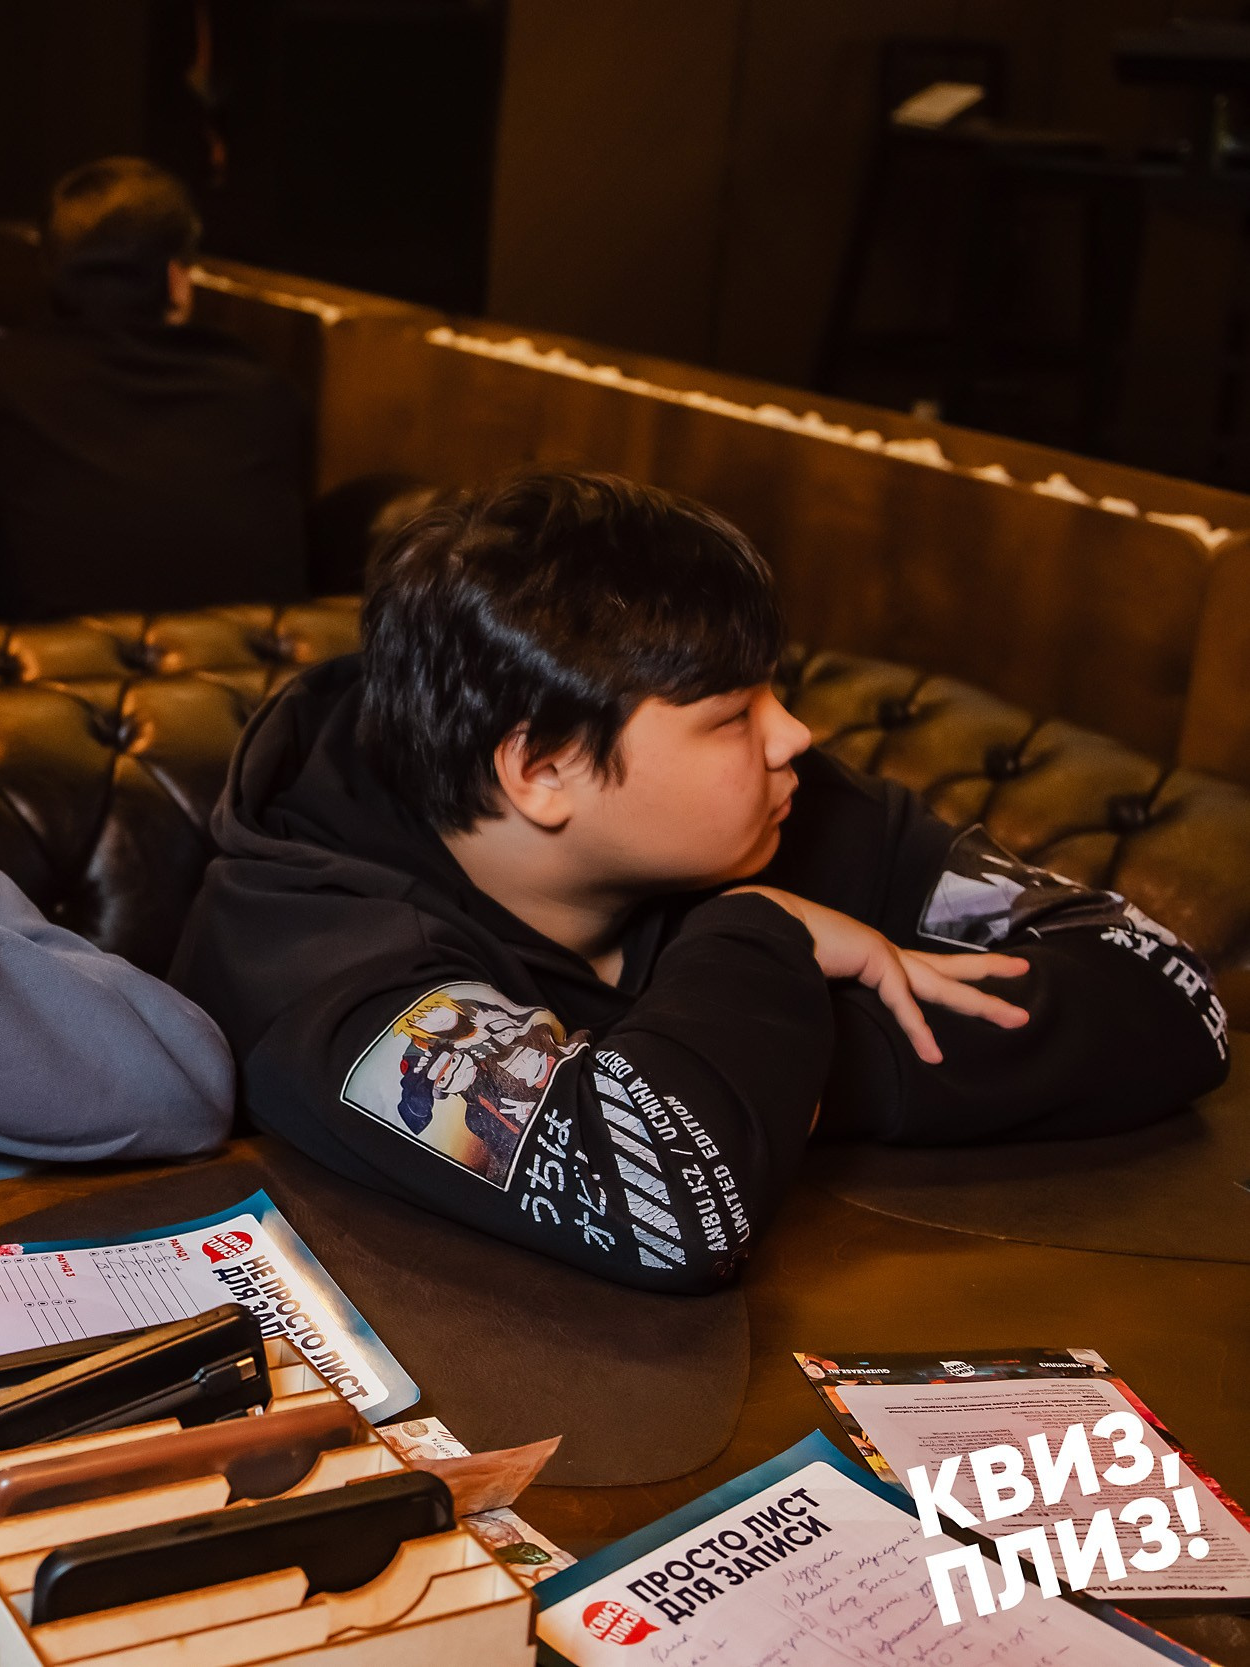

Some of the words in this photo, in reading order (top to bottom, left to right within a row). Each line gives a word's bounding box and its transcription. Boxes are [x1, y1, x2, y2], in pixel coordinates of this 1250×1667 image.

[627, 1076, 678, 1142] UCHIHA
[663, 1095, 720, 1160] EDITION
[520, 1109, 572, 1225] うちは
[682, 1164, 728, 1252] ANBU.KZ
[55, 1254, 71, 1273] РАУНД
[170, 1239, 188, 1259] РАУНД
[212, 1266, 261, 1302] ДЛЯ
[242, 1254, 271, 1280] НЕ
[258, 1276, 328, 1350] ПРОСТО
[311, 1349, 370, 1400] ЛИСТ
[626, 1530, 748, 1603] ПРОСТО
[741, 1488, 820, 1540] ЛИСТ
[654, 1577, 725, 1625] ДЛЯ
[714, 1514, 833, 1586] ЗАПИСИ
